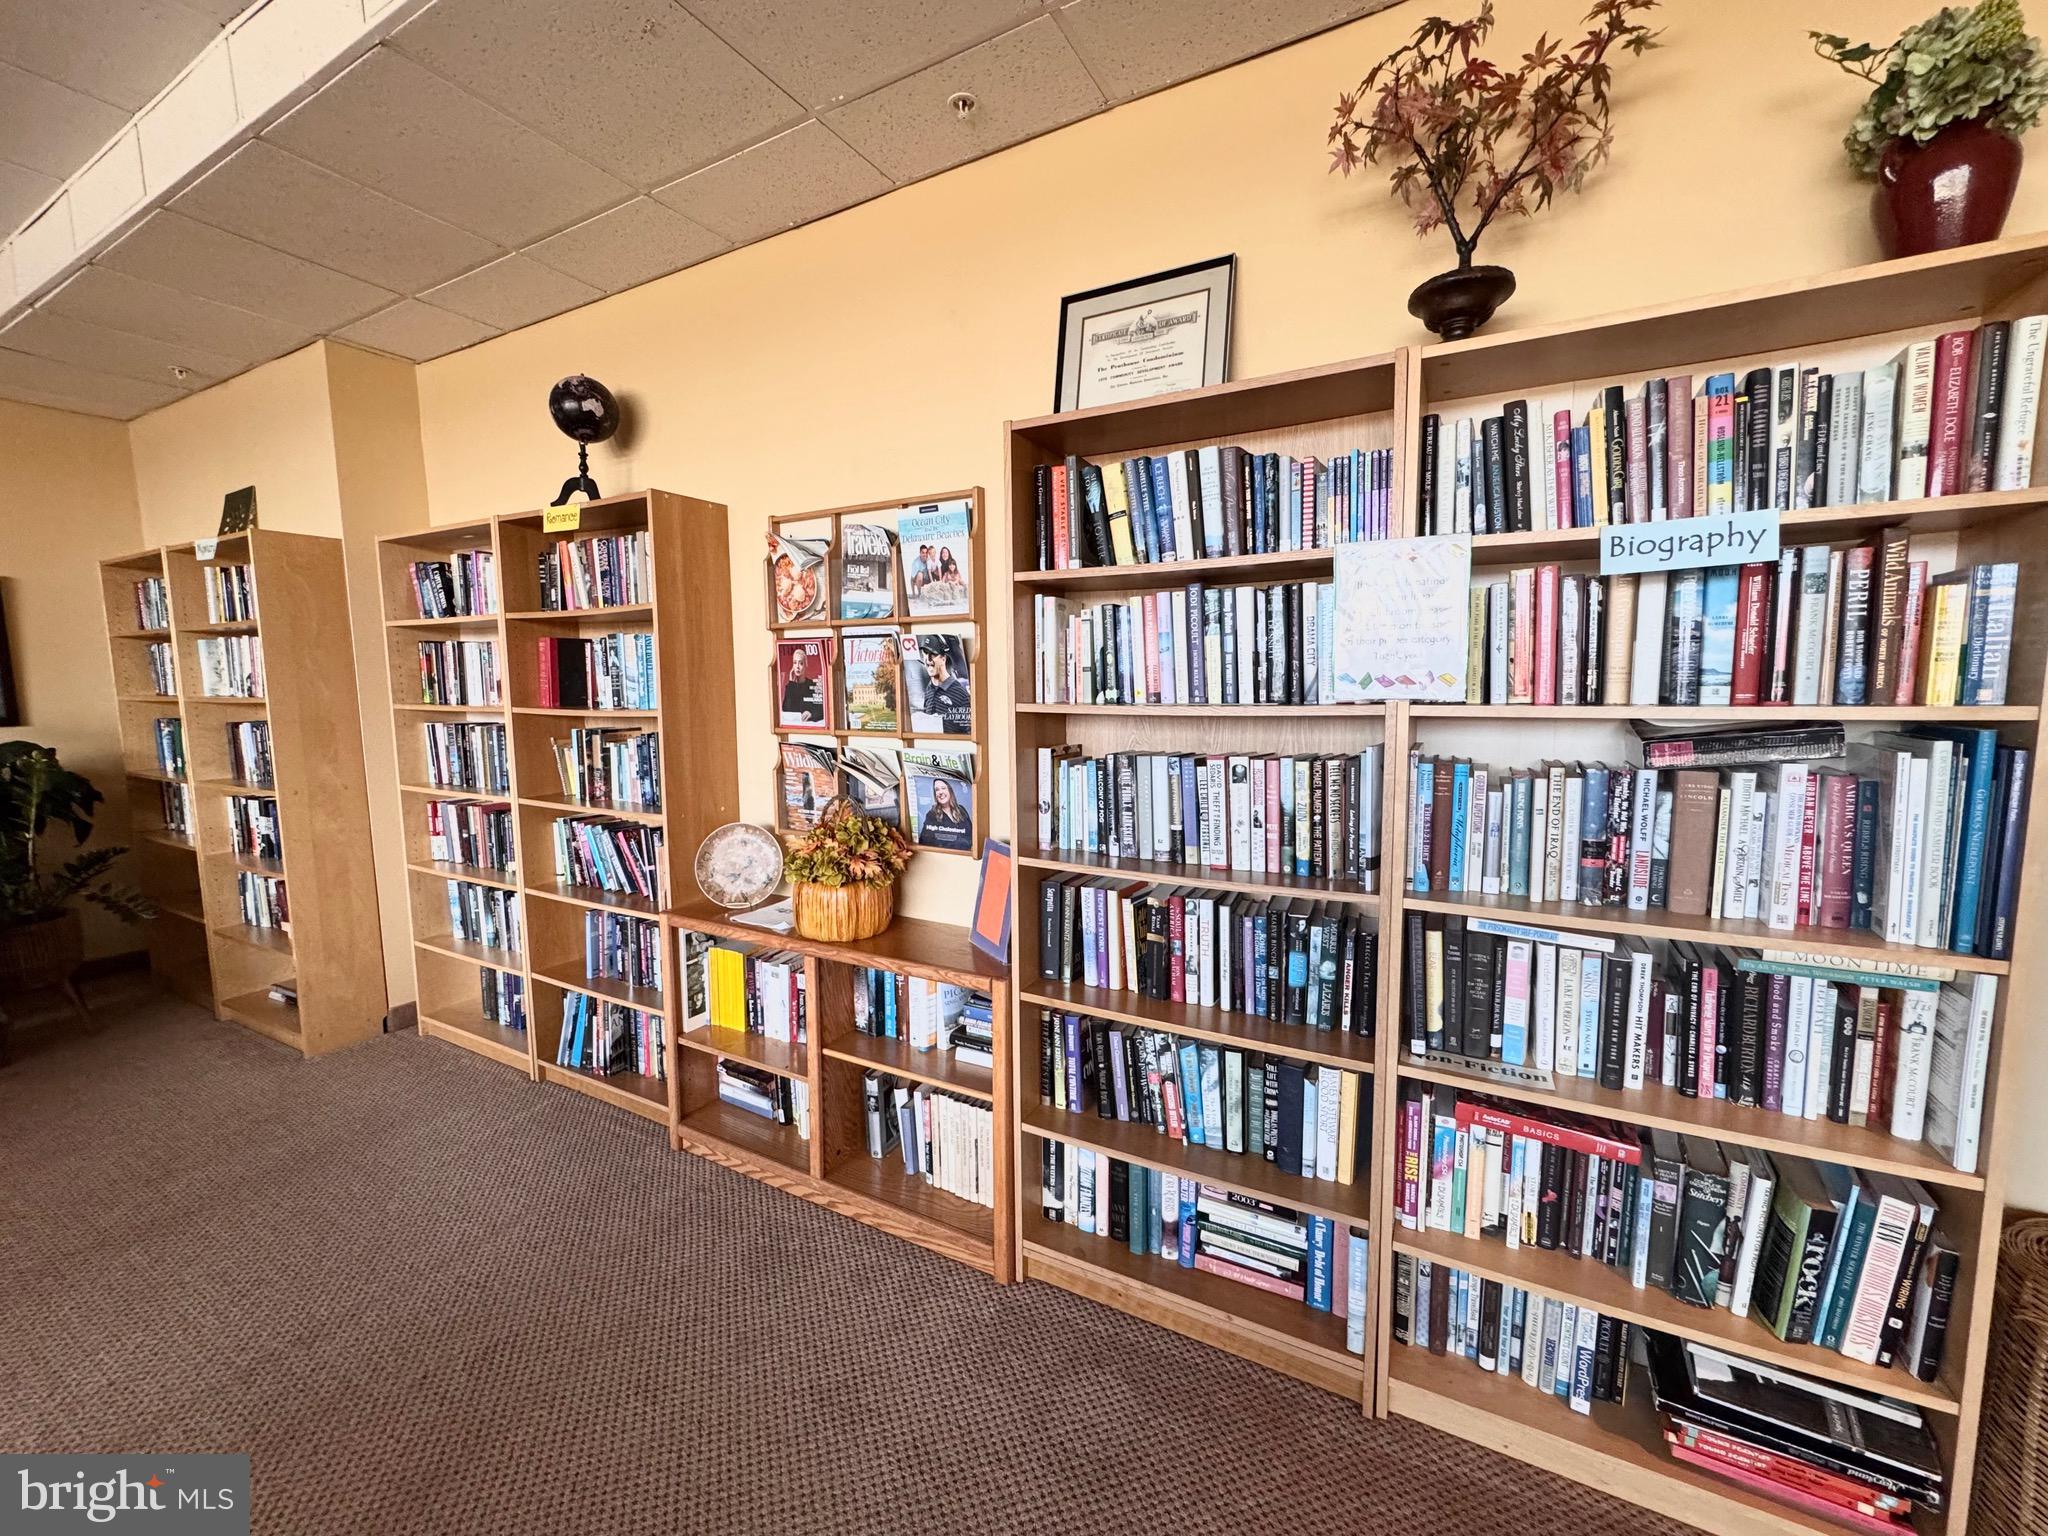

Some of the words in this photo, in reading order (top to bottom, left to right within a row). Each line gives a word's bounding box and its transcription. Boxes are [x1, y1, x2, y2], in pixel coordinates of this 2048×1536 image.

[2028, 320, 2042, 340] The
[1952, 336, 1964, 356] BOB
[1914, 346, 1930, 380] VALIANT
[2020, 342, 2040, 396] Ungrateful
[1715, 386, 1729, 394] BOX
[1715, 394, 1729, 406] 21
[1912, 382, 1930, 414] WOMEN
[1946, 366, 1962, 414] ELIZABETH
[1510, 408, 1522, 427] My
[2016, 396, 2033, 436] Refugee
[1426, 426, 1434, 454] BUREAU
[1490, 422, 1500, 450] WATCH
[1510, 428, 1525, 454] Lucky
[1944, 417, 1957, 443] DOLE
[1154, 462, 1162, 475] ICE
[1490, 450, 1498, 462] ME
[1514, 454, 1526, 478] Stars
[1678, 460, 1686, 476] Theo
[1137, 460, 1146, 492] DANIELLE
[1154, 476, 1166, 500] REICH
[1424, 471, 1432, 491] MOLE
[1492, 464, 1500, 499] ANJELICA
[1141, 492, 1151, 512] STEEL
[1678, 478, 1686, 504] Aronson
[546, 511, 579, 525] Romance
[911, 516, 934, 528] Ocean
[934, 513, 950, 526] City
[1492, 500, 1502, 529] HUSTON
[902, 532, 936, 544] Delaware
[936, 530, 965, 541] Beaches
[1093, 520, 1106, 560] TOWER
[1609, 521, 1767, 562] Biography
[1884, 540, 1908, 571] Wild
[1189, 586, 1198, 606] JODI
[1750, 575, 1762, 602] William
[1846, 568, 1871, 621] PERIL
[1881, 572, 1905, 627] Animals
[1748, 602, 1760, 626] Donald
[1190, 610, 1200, 646] PICOULT
[1305, 616, 1316, 645] DRAMA
[1747, 626, 1758, 656] Schaefer
[1855, 630, 1866, 644] BOB
[1880, 628, 1888, 637] OF
[804, 644, 818, 656] 100
[902, 638, 917, 651] CR
[1878, 638, 1888, 660] NORTH
[1981, 603, 2014, 680] Italian
[1306, 648, 1316, 667] CITY
[1853, 644, 1865, 679] WOODWARD
[1875, 660, 1885, 689] AMERICA
[1313, 761, 1322, 788] MICHAEL
[1474, 774, 1486, 800] GUERRILLA
[1552, 774, 1562, 792] THE
[1213, 791, 1221, 814] THEFT
[1313, 789, 1322, 814] PALMER
[1642, 778, 1652, 813] MICHAEL
[1740, 778, 1752, 802] JUDITH
[1805, 782, 1816, 807] URBAN
[1550, 792, 1562, 816] END
[1843, 782, 1855, 839] AMERICA'S
[1974, 789, 1986, 830] GLORIOUS
[926, 824, 938, 833] High
[938, 824, 966, 834] Cholesterol
[1472, 802, 1484, 834] ADVERTISING
[1550, 818, 1560, 832] OF
[1639, 814, 1650, 842] WOLFF
[1738, 804, 1752, 835] MICHAEL
[1803, 809, 1814, 834] MEYER
[1213, 819, 1222, 846] FINDING
[1313, 825, 1322, 838] THE
[1860, 820, 1872, 850] REBELS
[1313, 840, 1322, 866] PATIENT
[1546, 832, 1560, 859] IRAQ
[1800, 845, 1812, 870] ABOVE
[1842, 840, 1854, 876] QUEEN
[1966, 831, 1983, 886] NEEDLEPOINT
[1633, 850, 1650, 889] LANDSLIDE
[1781, 842, 1796, 880] MEDICAL
[1858, 852, 1870, 880] RISING
[1800, 871, 1810, 886] THE
[1045, 887, 1056, 912] Scarpetta
[1780, 882, 1792, 906] TESTS
[1799, 886, 1810, 903] LINE
[1174, 913, 1182, 933] SOUL
[1270, 914, 1278, 938] MAEVE
[1097, 927, 1105, 952] STORM
[1200, 920, 1210, 958] TRUTH
[1322, 926, 1330, 949] WEST
[1329, 922, 1338, 954] MORRIS
[1270, 940, 1278, 966] BINCHY
[1792, 951, 1861, 969] MOON
[1873, 960, 1928, 978] TIME
[1343, 962, 1352, 990] ANGER
[1639, 962, 1647, 980] DEREK
[1690, 970, 1698, 982] THE
[1564, 978, 1576, 999] LAKE
[1583, 972, 1592, 998] MIND
[1637, 982, 1646, 1014] THOMPSON
[1690, 982, 1698, 994] END
[1690, 994, 1698, 1002] OF
[1772, 974, 1784, 1000] Blood
[1562, 1000, 1574, 1035] WOBEGON
[1634, 1016, 1644, 1030] HIT
[1689, 1002, 1697, 1026] PRIVACY
[1742, 986, 1758, 1034] RICHARD
[1772, 1002, 1782, 1020] and
[1769, 1022, 1782, 1052] Smoke
[1631, 1033, 1644, 1070] MAKERS
[1740, 1034, 1758, 1074] BURTON
[1909, 1037, 1923, 1064] FRANK
[1320, 1069, 1330, 1102] BLOOD
[1904, 1067, 1921, 1109] McCOURT
[1319, 1104, 1329, 1134] SPORT
[1522, 1125, 1560, 1141] BASICS
[1403, 1156, 1419, 1182] RISE
[1232, 1192, 1256, 1207] 2003
[1314, 1250, 1326, 1268] Debt
[1793, 1242, 1830, 1310] rock
[1313, 1276, 1326, 1303] Honor
[1896, 1278, 1912, 1310] WIRING
[1597, 1320, 1612, 1352] PICOULT
